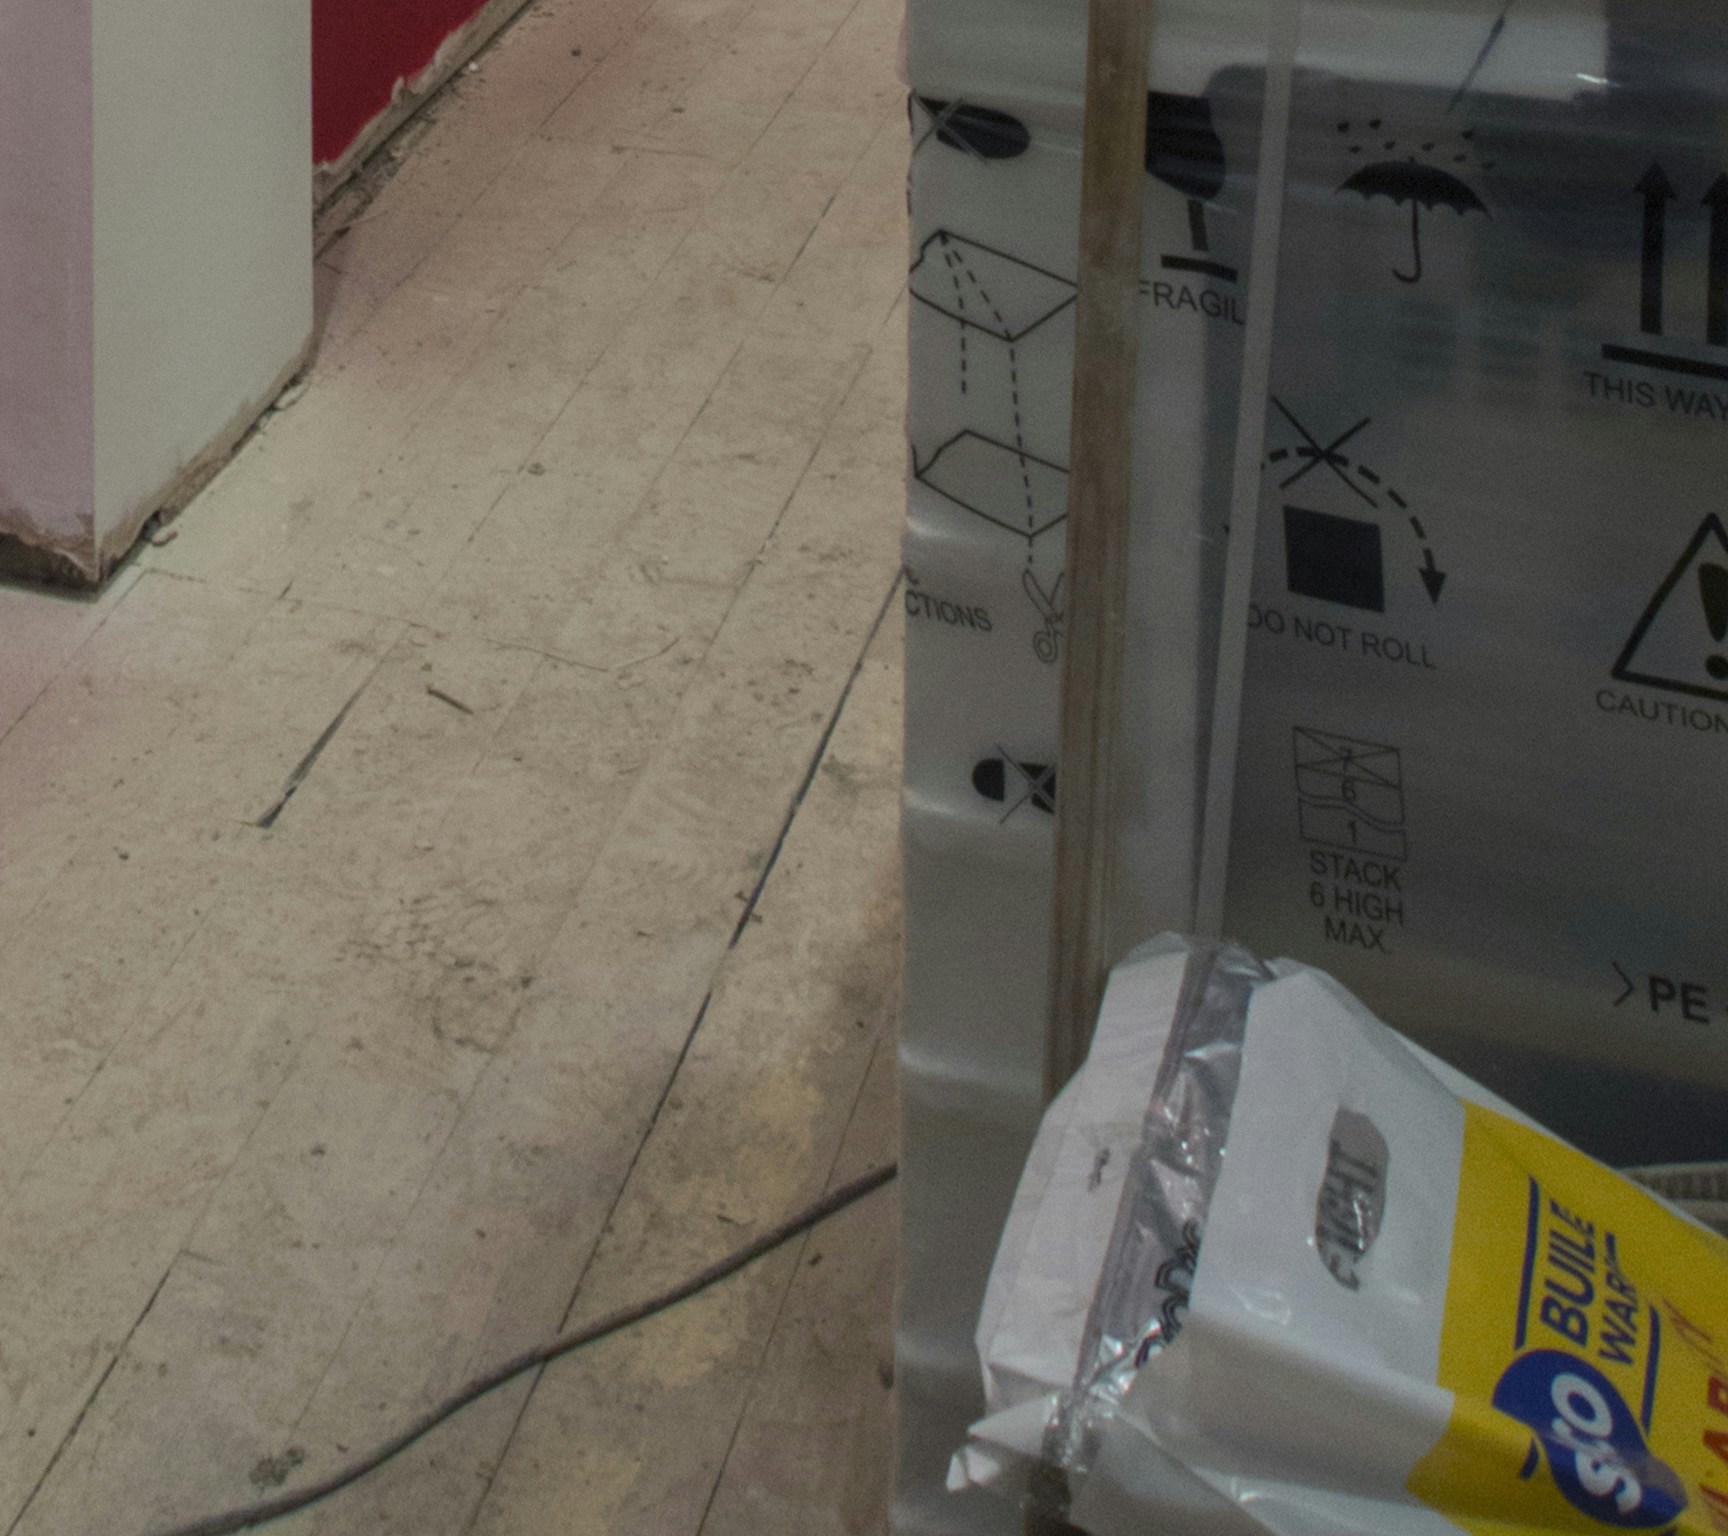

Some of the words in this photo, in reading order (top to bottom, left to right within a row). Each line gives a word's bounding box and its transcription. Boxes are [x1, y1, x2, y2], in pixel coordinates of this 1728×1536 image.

[1139, 279, 1248, 326] FRAGIL
[1584, 371, 1657, 409] THIS
[1294, 616, 1352, 650] NOT
[1361, 631, 1438, 670] ROLL
[1309, 849, 1403, 892] STACK
[1309, 880, 1326, 908] 6
[1334, 885, 1404, 925] HIGH
